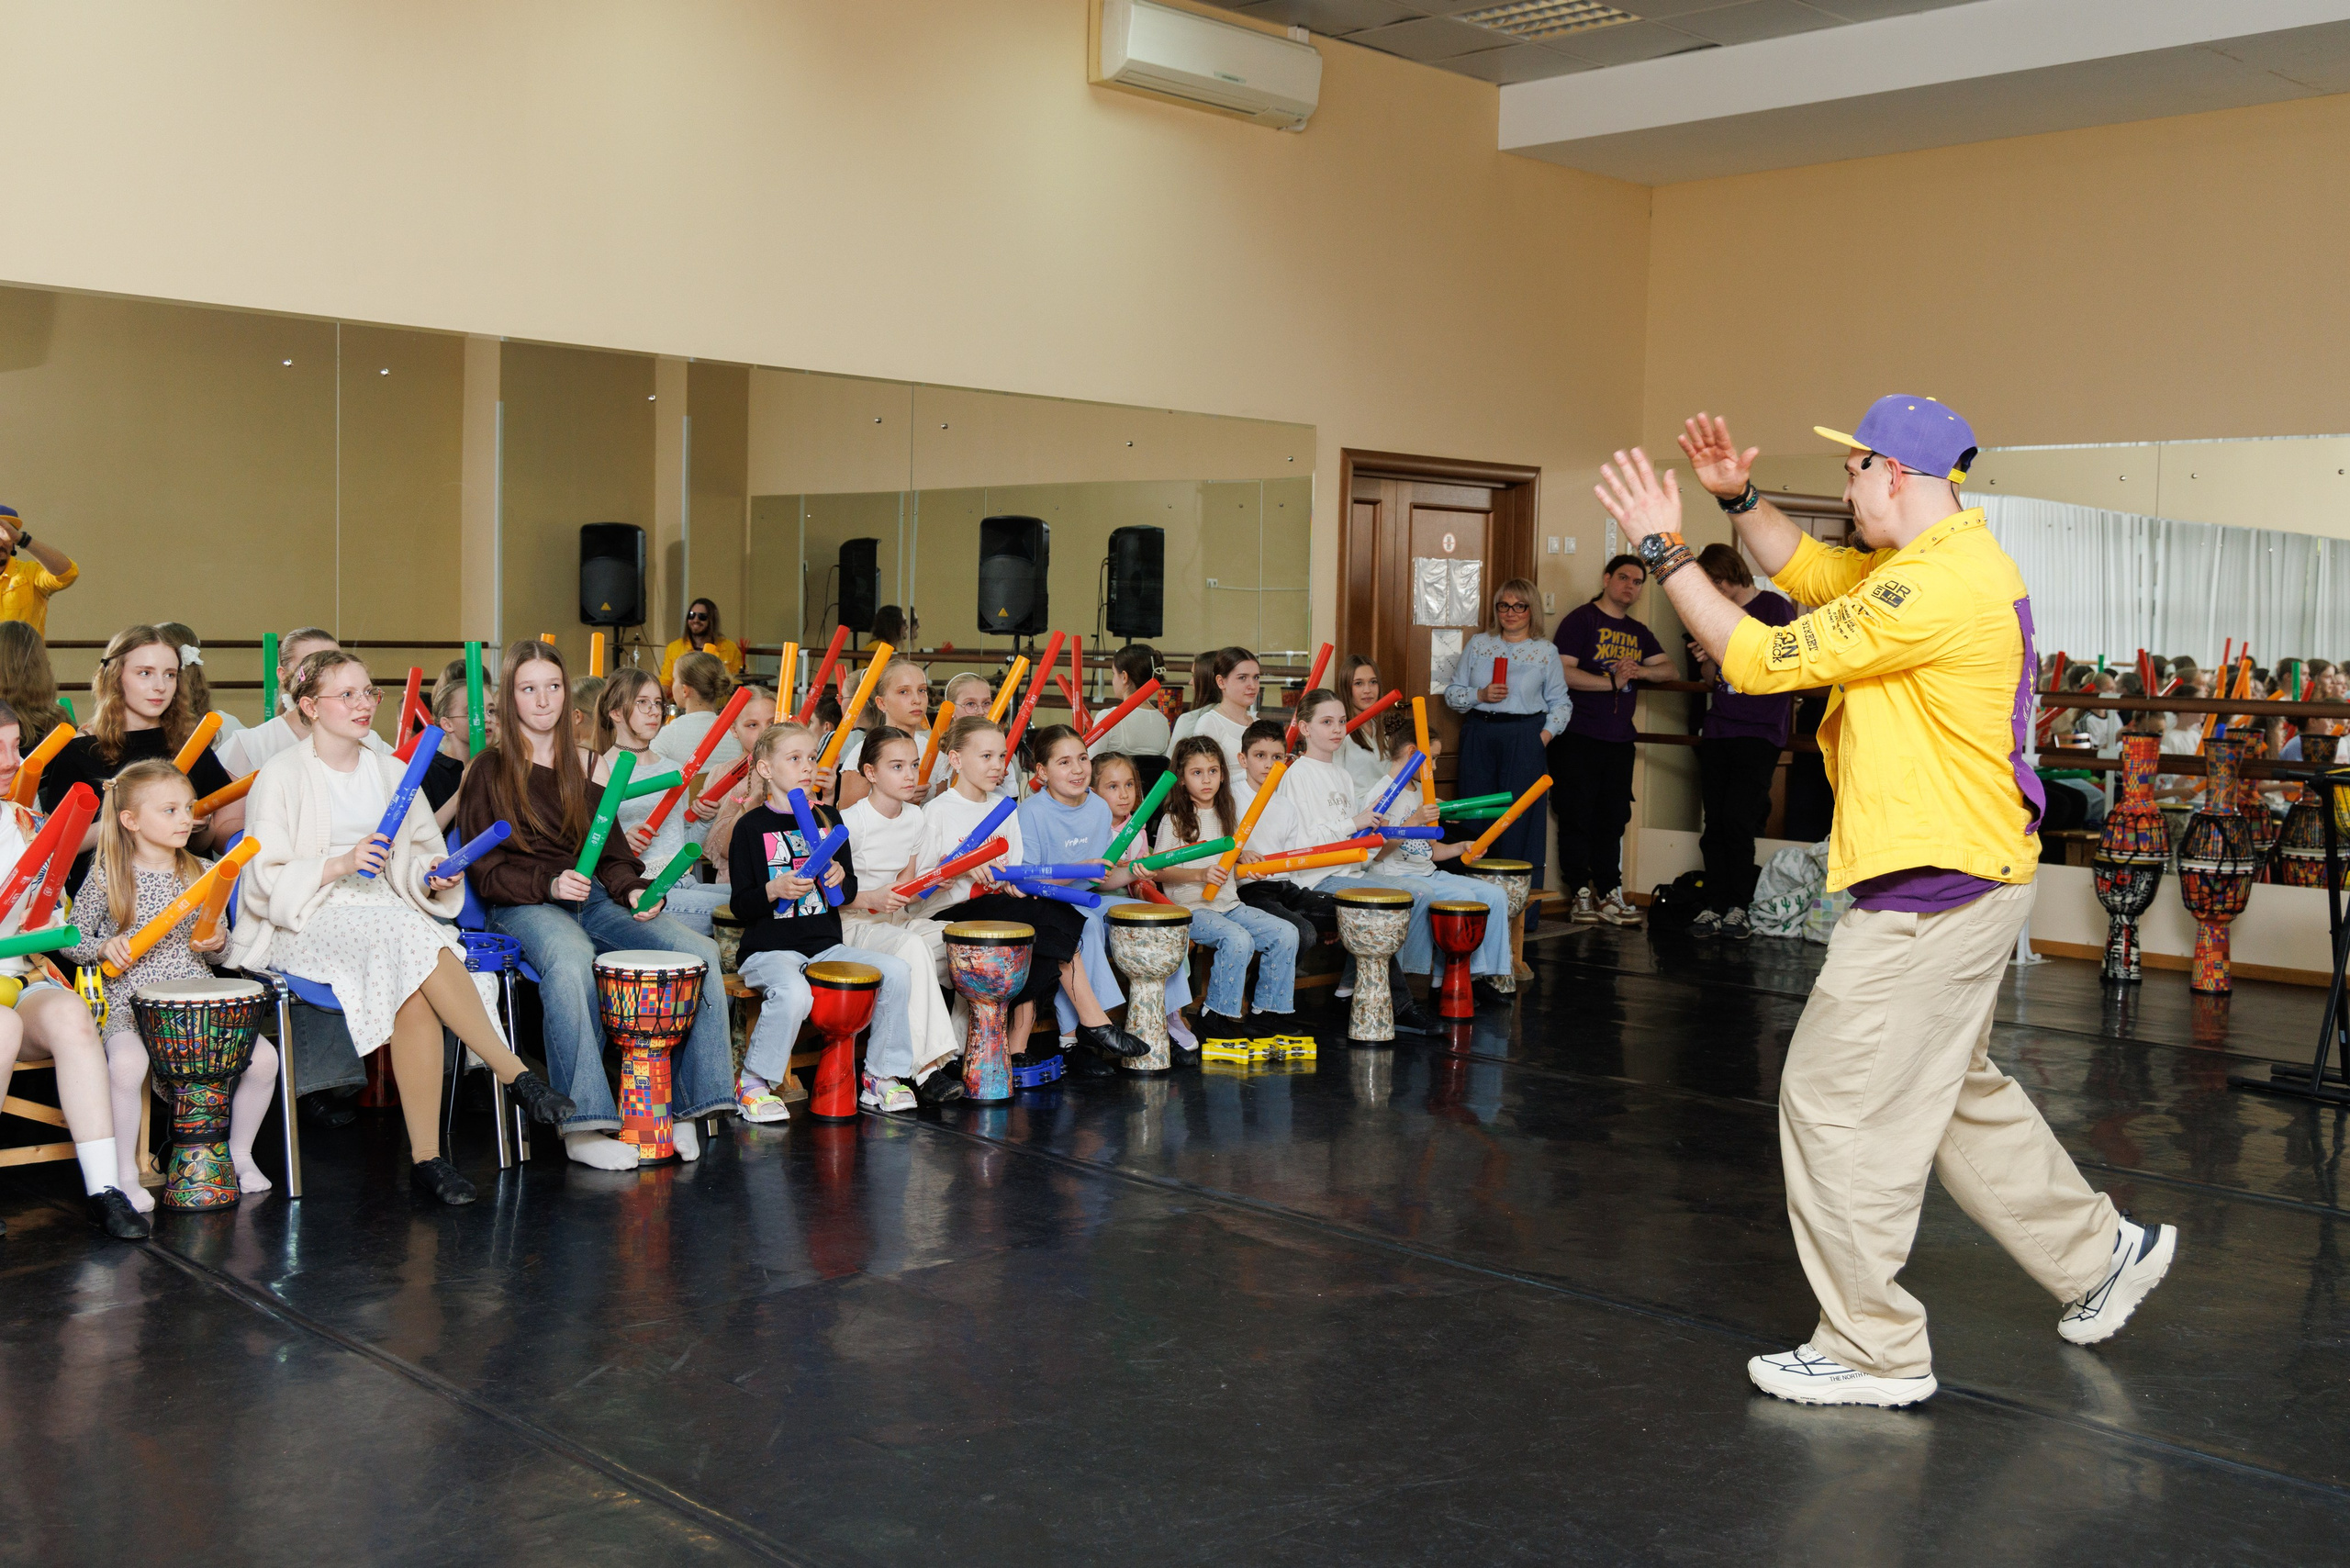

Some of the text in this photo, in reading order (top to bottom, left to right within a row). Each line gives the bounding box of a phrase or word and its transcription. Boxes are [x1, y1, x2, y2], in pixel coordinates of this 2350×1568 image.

[1802, 621, 1818, 651] STREET
[1594, 644, 1642, 661] ЖИЗНИ
[1842, 1372, 1863, 1381] NORTH
